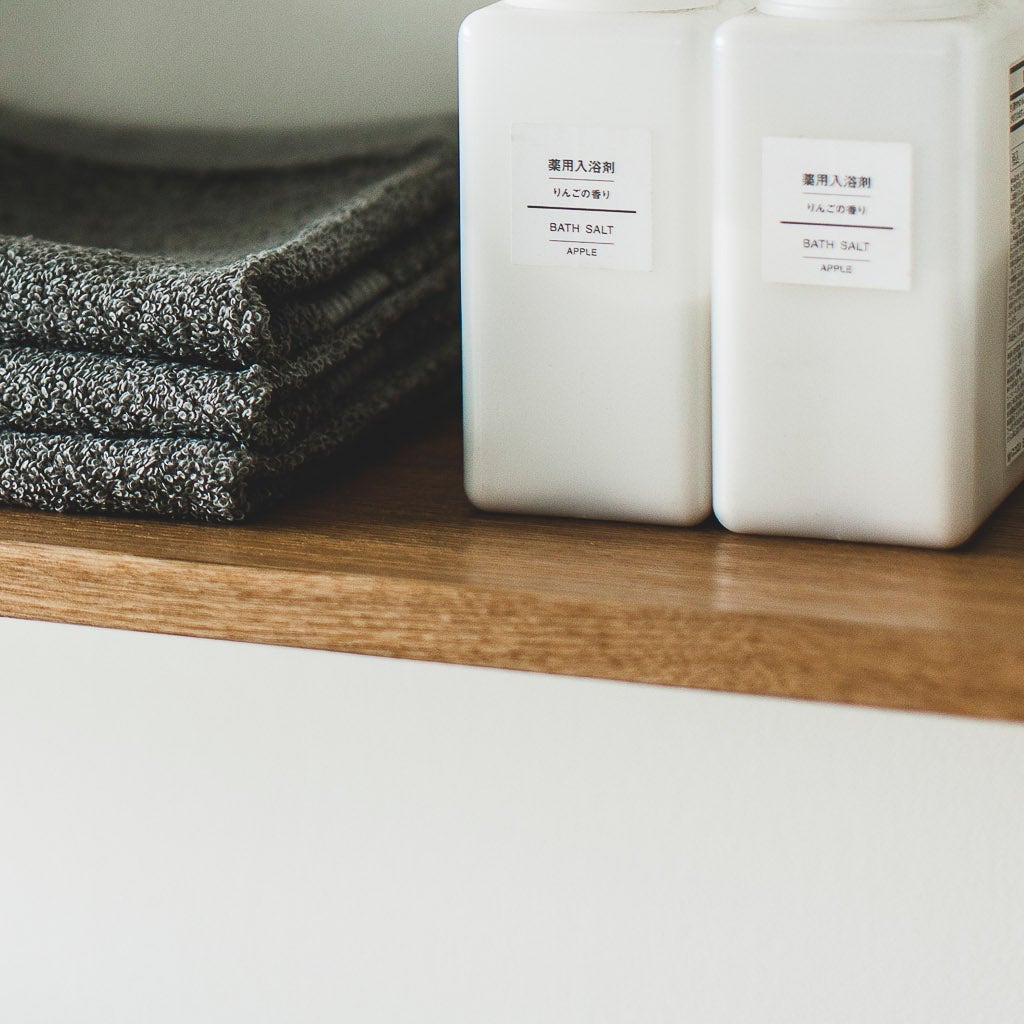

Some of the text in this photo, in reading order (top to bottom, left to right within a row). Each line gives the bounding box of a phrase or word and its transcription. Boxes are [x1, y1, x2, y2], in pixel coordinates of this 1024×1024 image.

[548, 158, 614, 174] 薬用入浴剤
[802, 173, 872, 189] 薬用入浴剤
[553, 187, 611, 200] りんごの香り
[806, 203, 868, 216] りんごの香り
[549, 222, 614, 235] BATH SALT
[803, 238, 871, 251] BATH SALT
[566, 247, 597, 257] APPLE
[820, 264, 853, 274] APPLE
